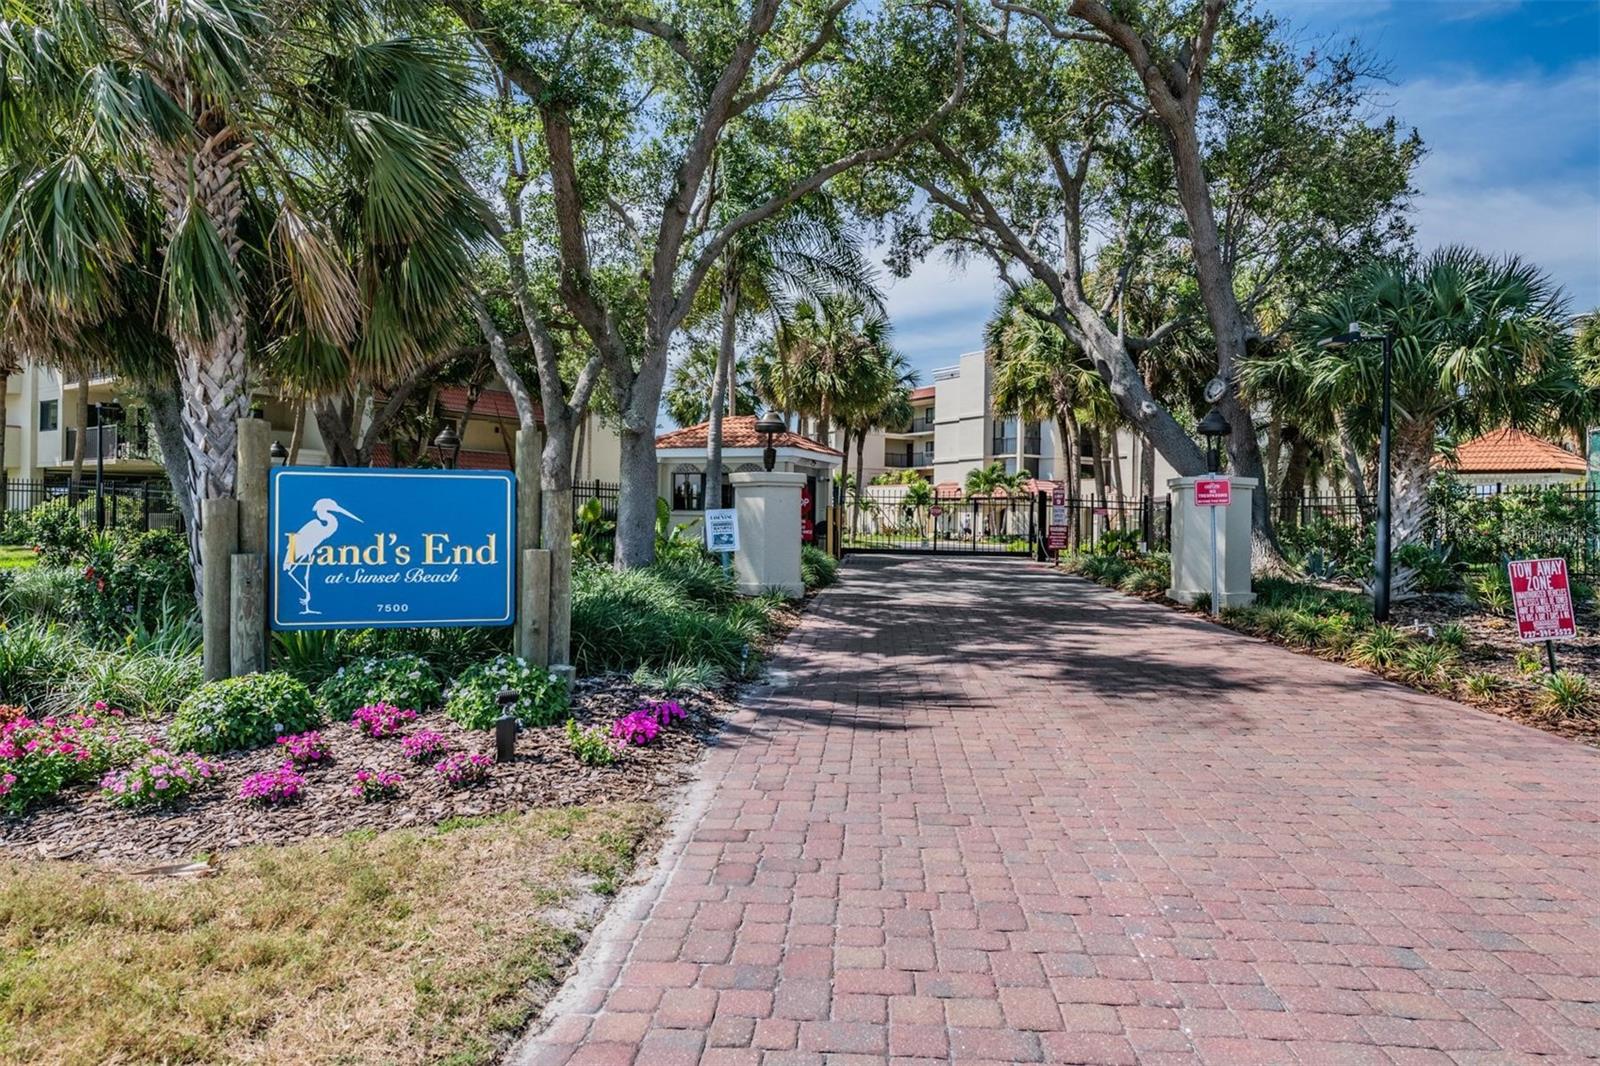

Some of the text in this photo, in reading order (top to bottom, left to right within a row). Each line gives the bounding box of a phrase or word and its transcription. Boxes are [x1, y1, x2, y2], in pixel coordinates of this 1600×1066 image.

[284, 532, 498, 566] Land's End
[325, 567, 460, 584] at Sunset Beach
[1511, 560, 1562, 578] TOW AWAY
[1526, 575, 1554, 591] ZONE
[377, 604, 408, 612] 7500
